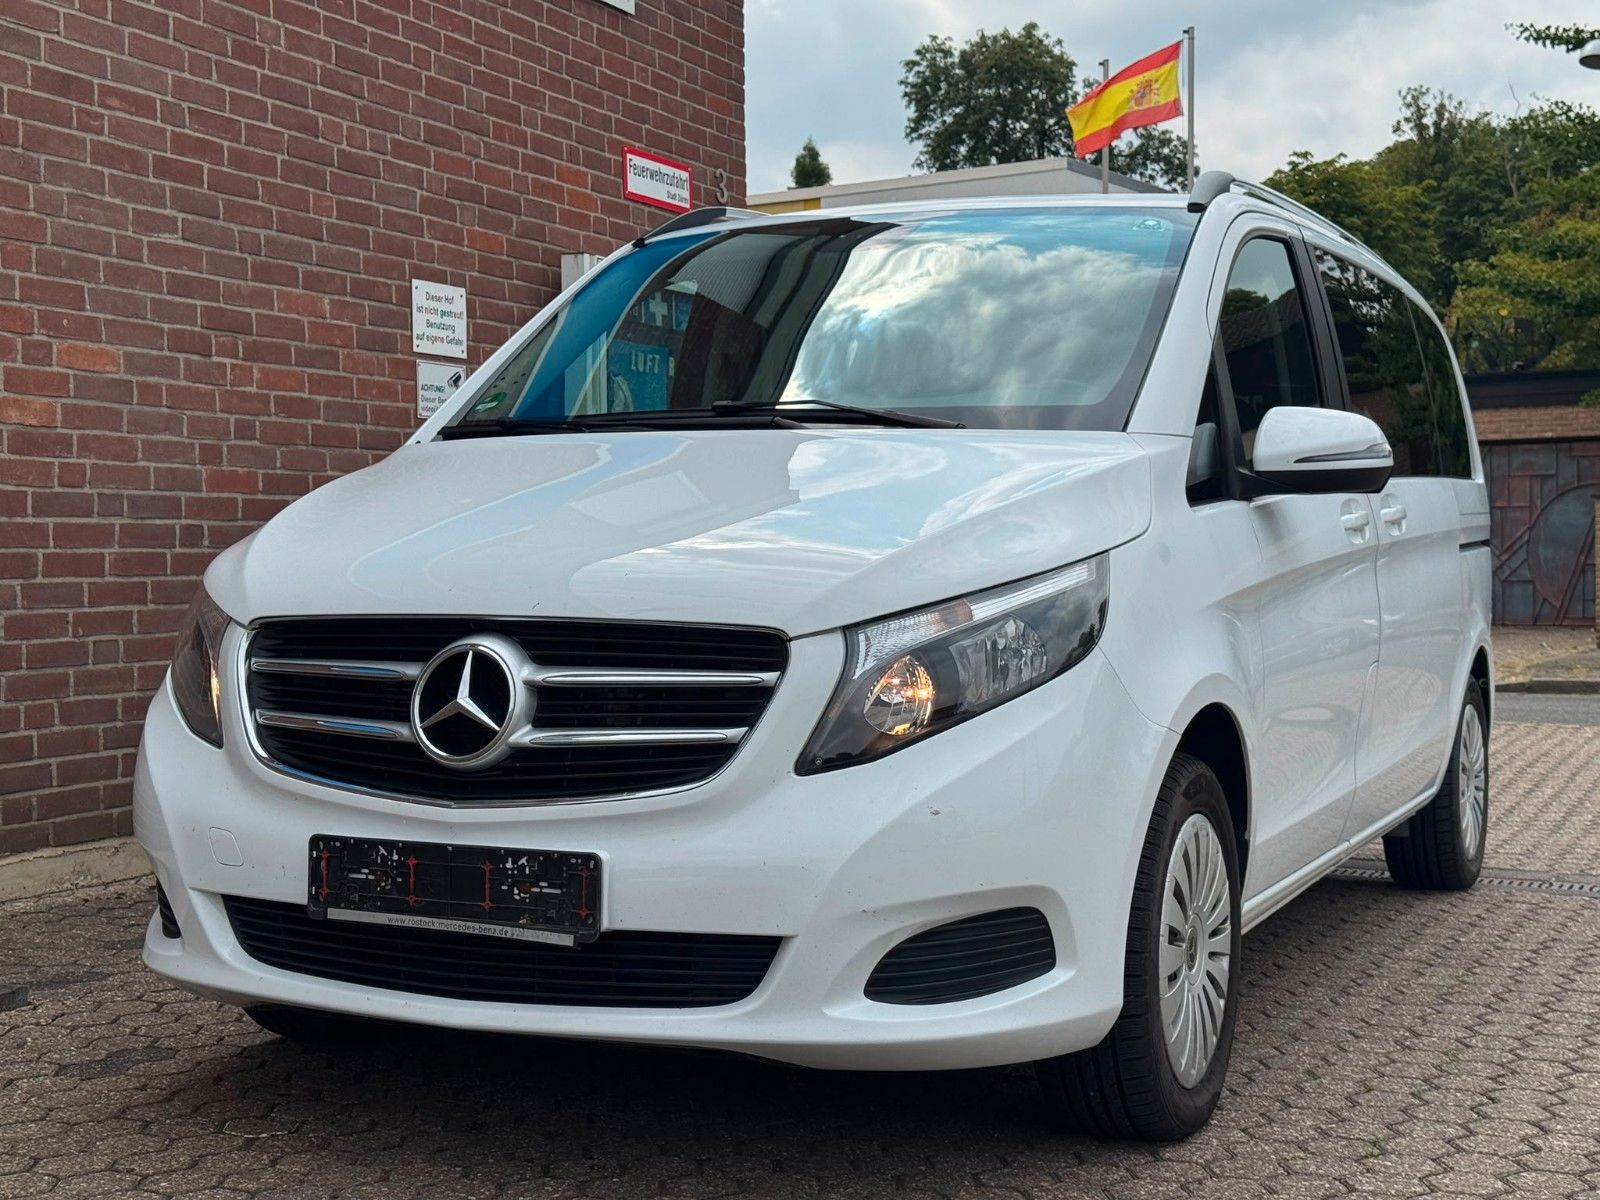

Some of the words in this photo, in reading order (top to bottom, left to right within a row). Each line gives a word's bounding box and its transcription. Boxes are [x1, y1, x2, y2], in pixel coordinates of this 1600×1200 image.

[628, 158, 689, 192] Feuerwehrzufahrt
[715, 168, 728, 204] 3
[425, 291, 443, 303] Dieser
[444, 294, 454, 305] Hof
[416, 304, 424, 313] ist
[425, 306, 439, 316] nicht
[425, 319, 456, 334] Benutzung
[416, 332, 425, 341] auf
[426, 333, 445, 344] eigene
[445, 335, 464, 346] Gefahr
[630, 350, 661, 374] LUFT
[387, 915, 509, 937] www.rostock.mercedes-benz.de
